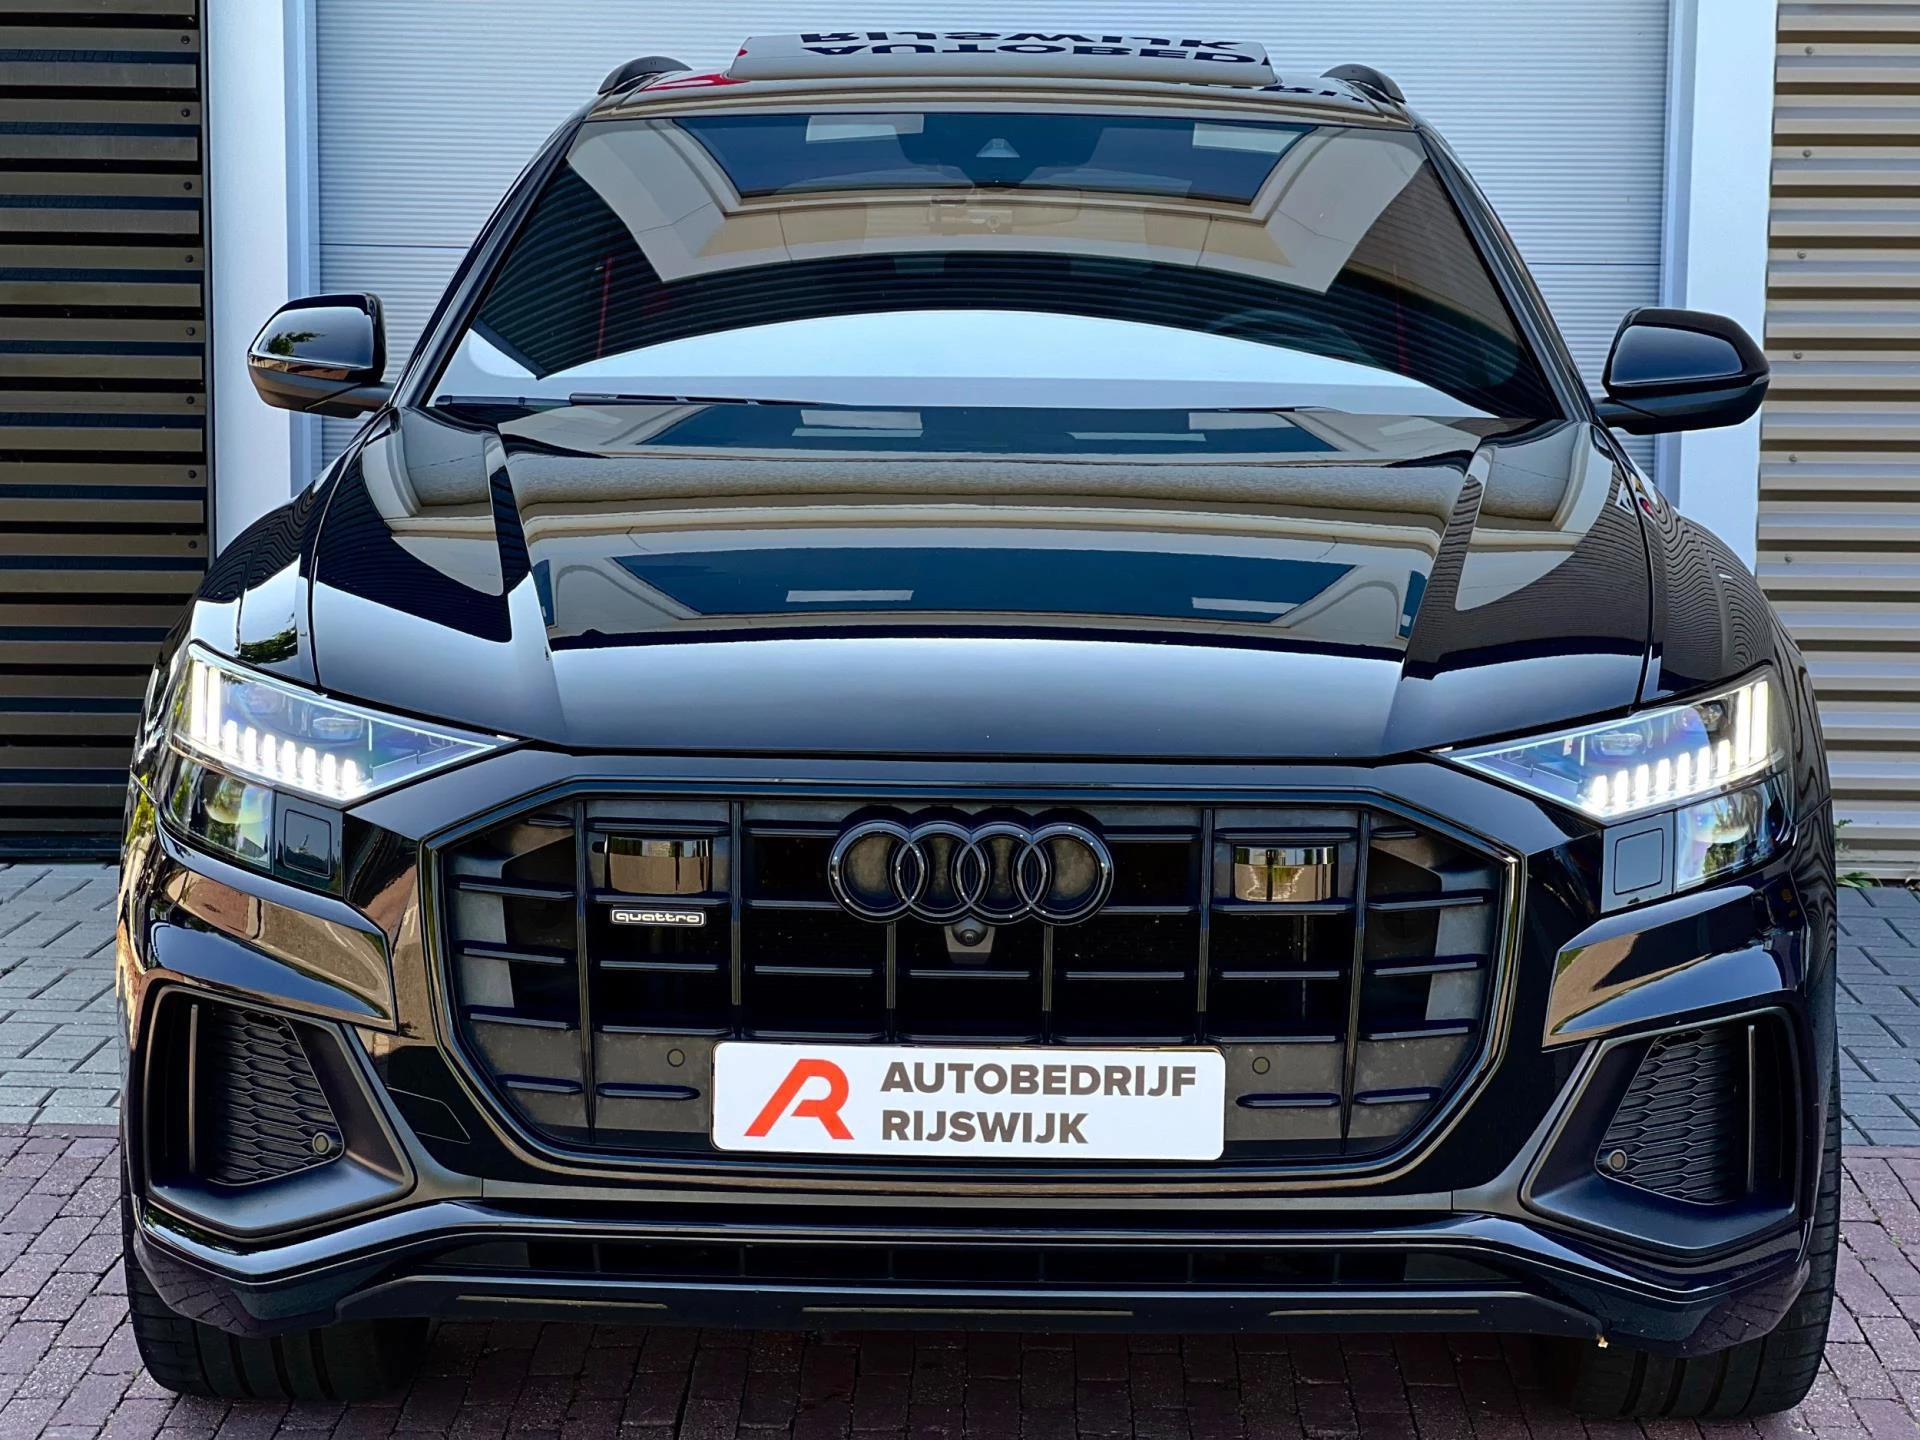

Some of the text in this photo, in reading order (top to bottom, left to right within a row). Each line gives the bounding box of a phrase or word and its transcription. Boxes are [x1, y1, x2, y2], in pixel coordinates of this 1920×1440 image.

[615, 912, 700, 923] quattro
[880, 1062, 1196, 1097] AUTOBEDRIJF
[881, 1109, 1089, 1144] RIJSWIJK
